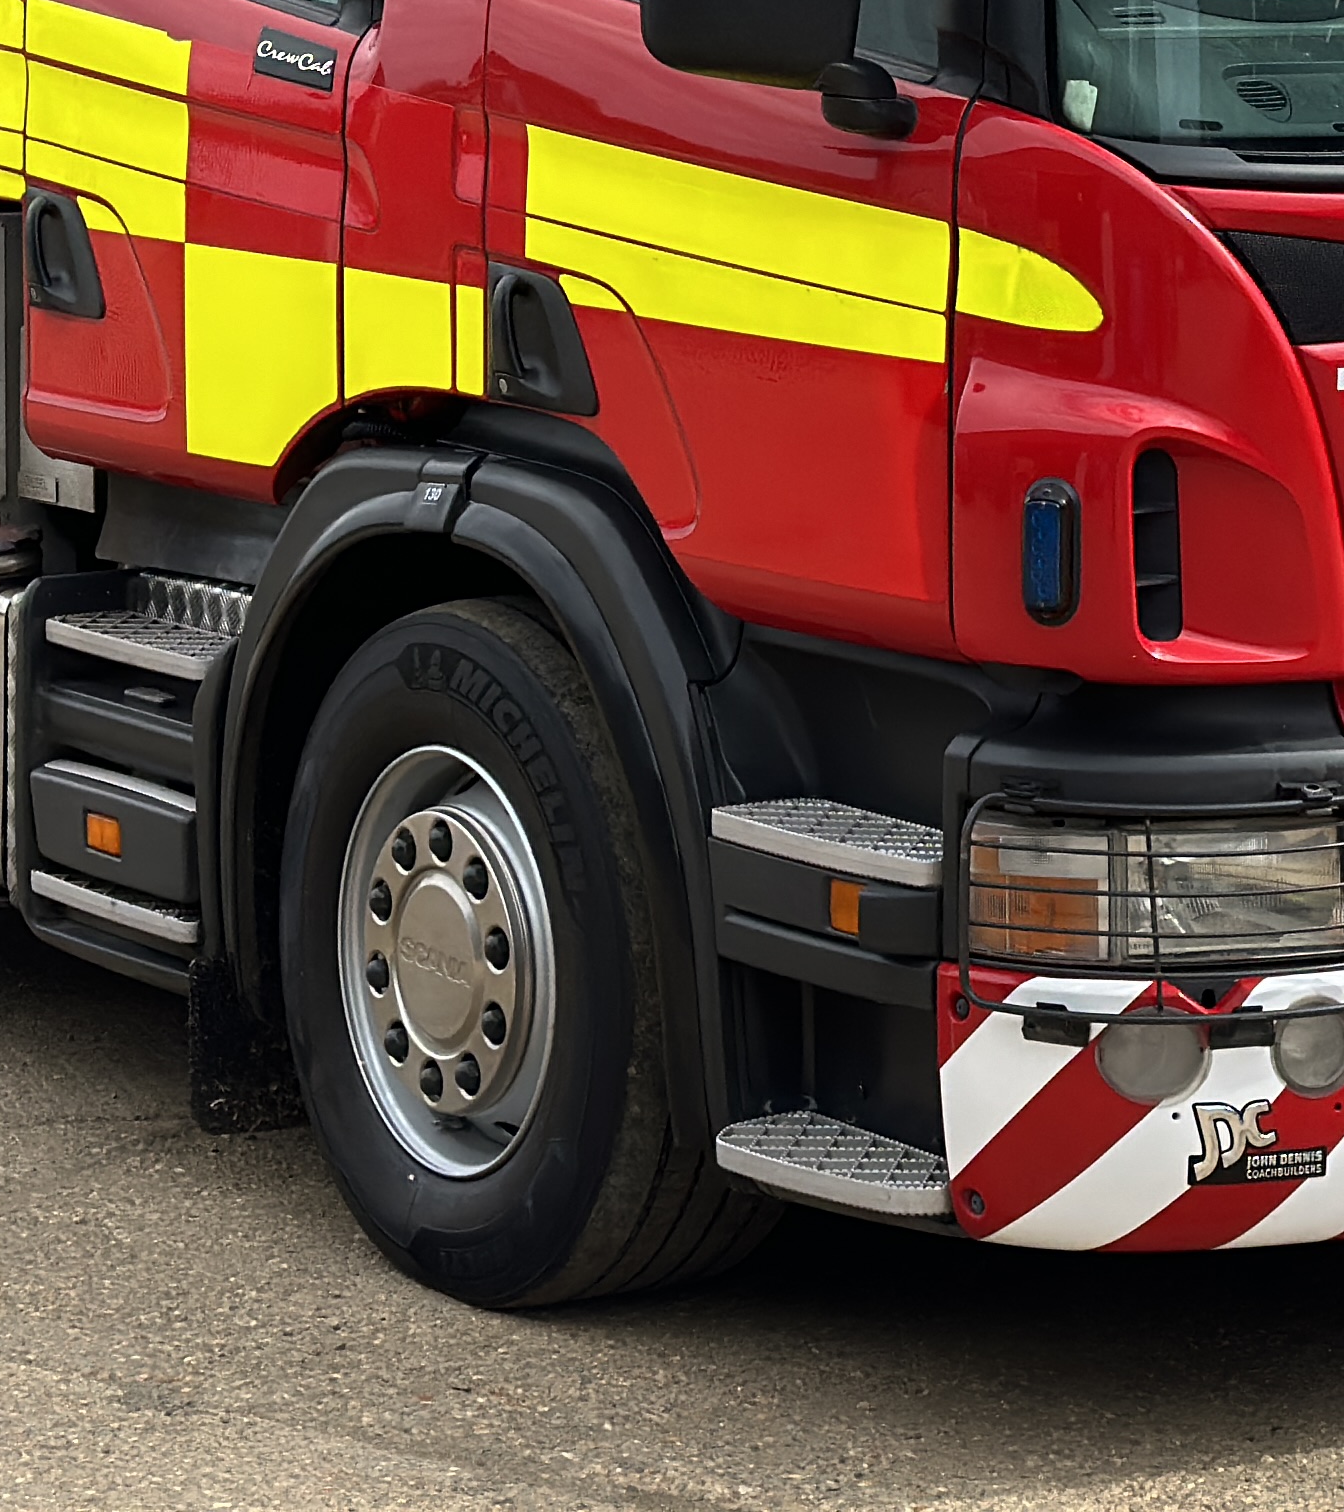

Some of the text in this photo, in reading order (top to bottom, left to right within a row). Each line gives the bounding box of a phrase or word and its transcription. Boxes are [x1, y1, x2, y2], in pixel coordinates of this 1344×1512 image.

[449, 658, 586, 892] MICHELIN
[1246, 1150, 1323, 1170] JOHN DENNIS
[1246, 1163, 1323, 1180] COACHBUILDERS
